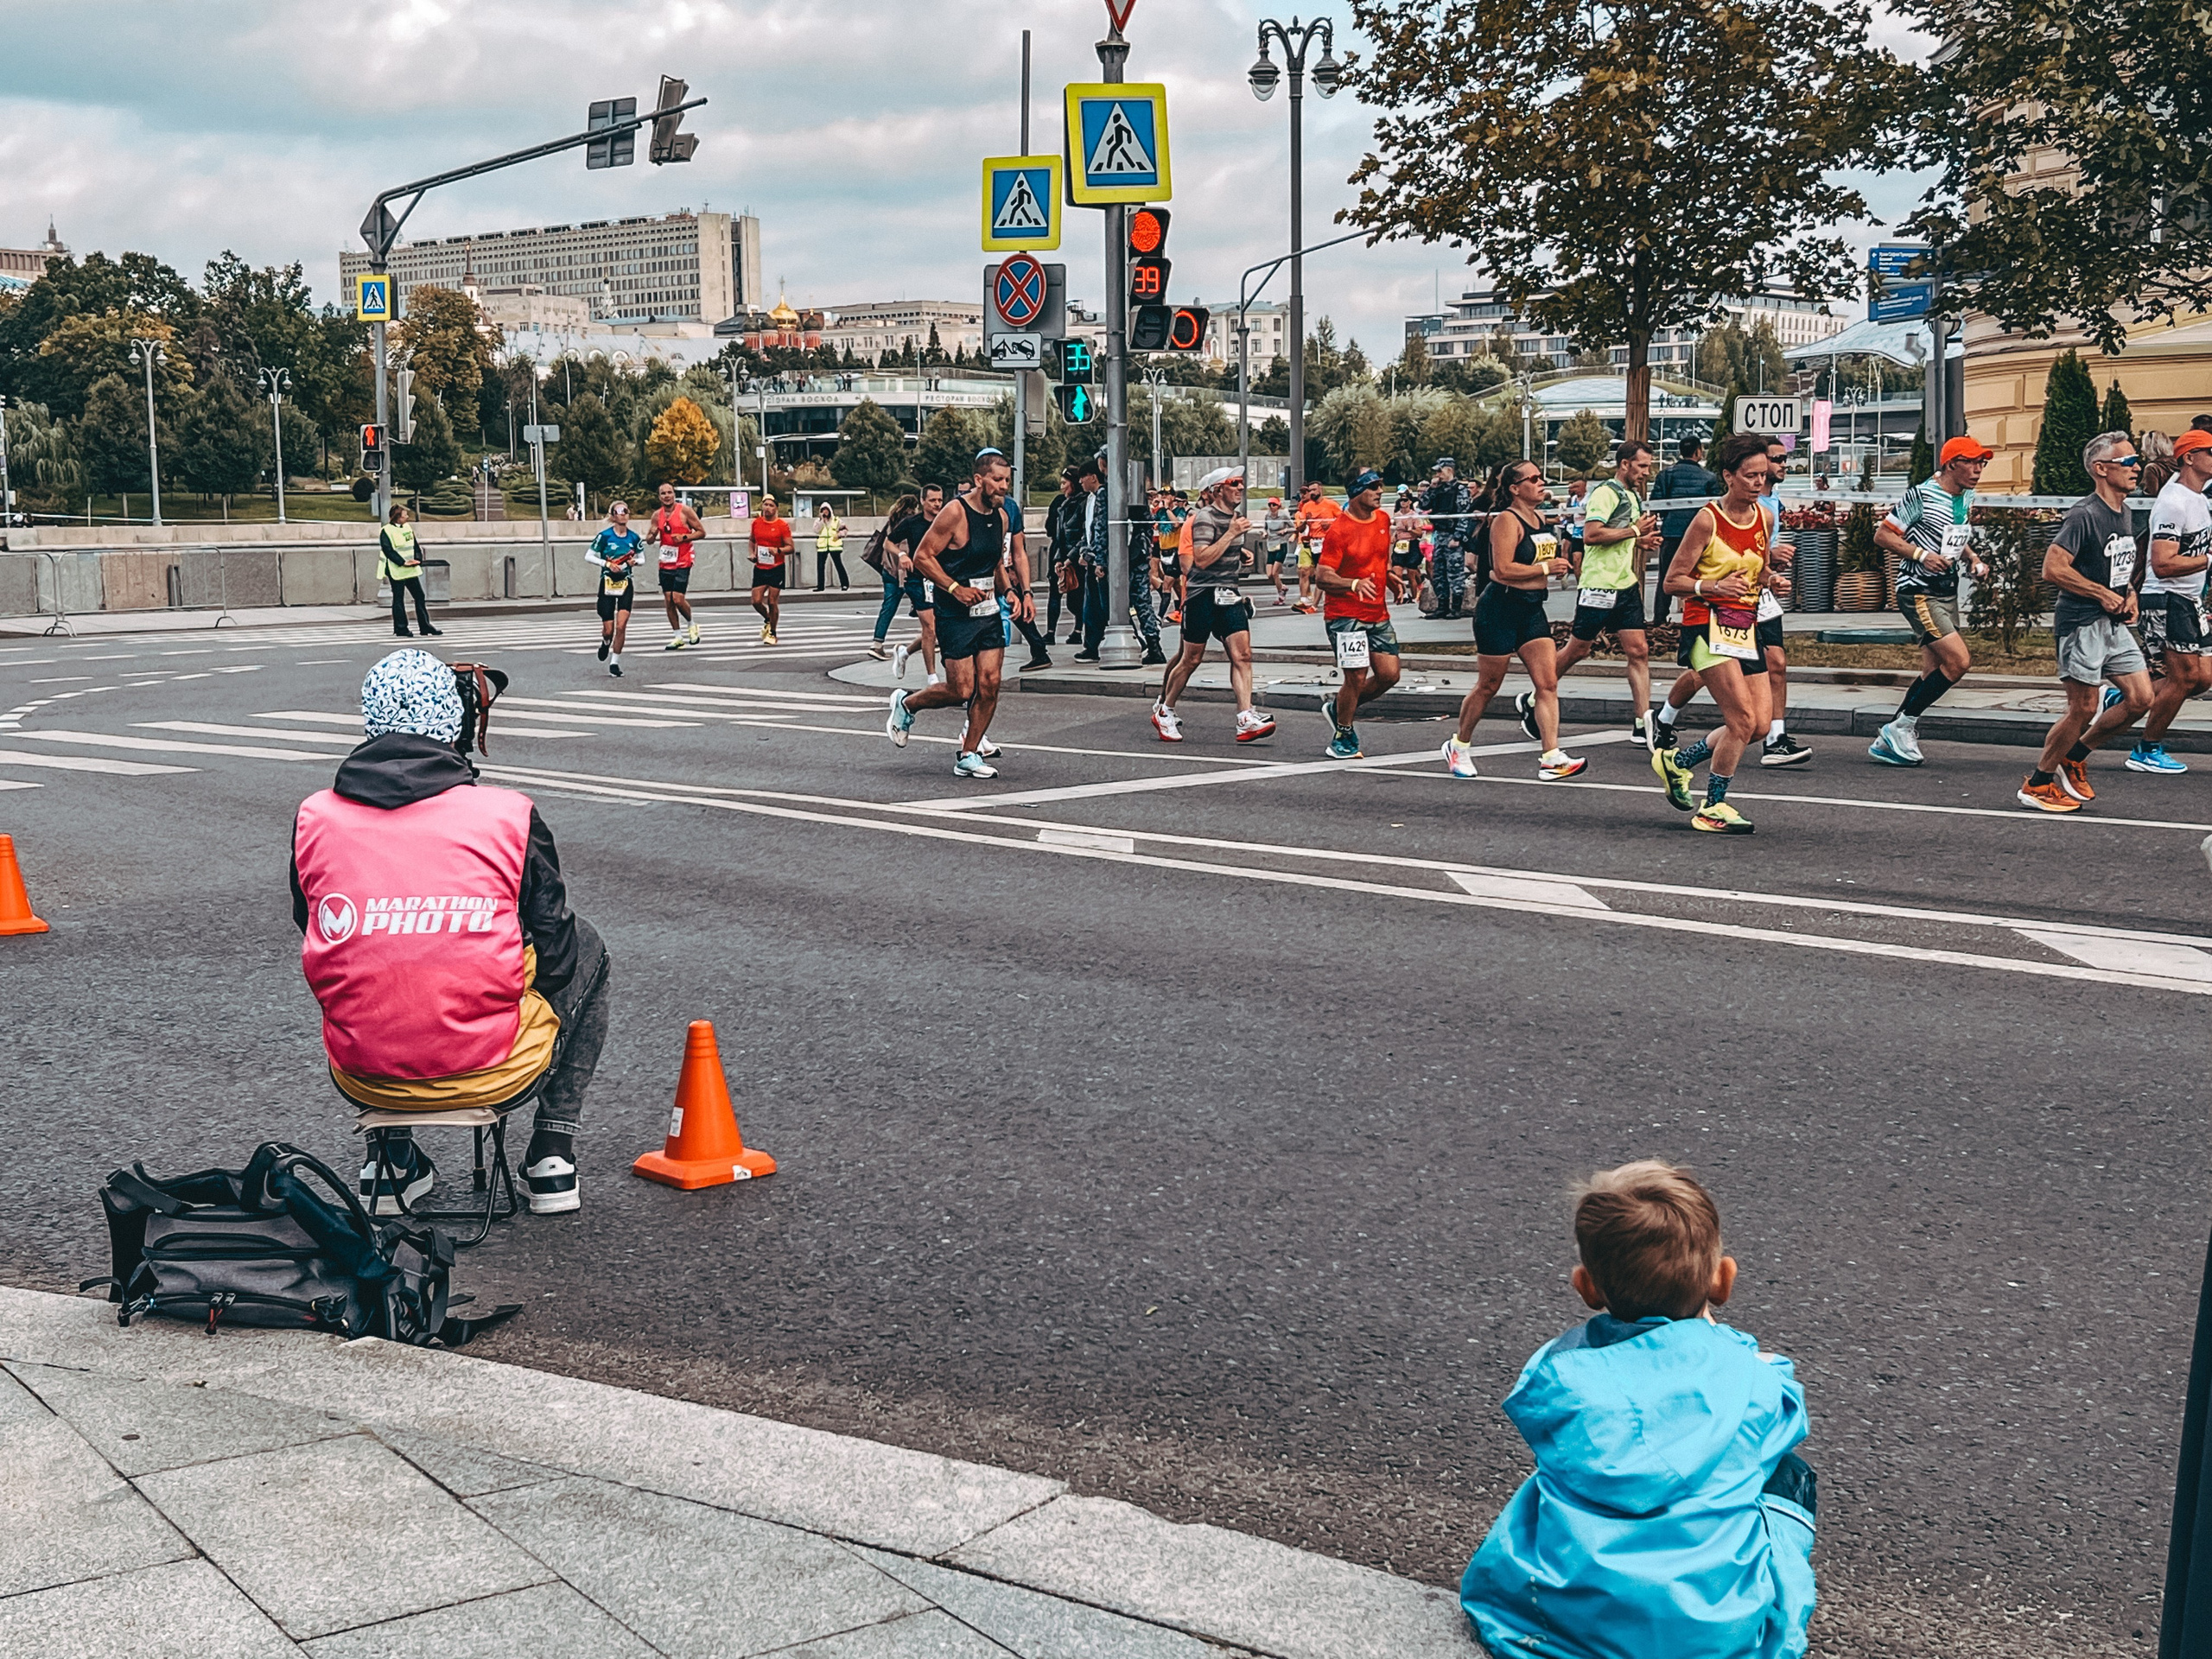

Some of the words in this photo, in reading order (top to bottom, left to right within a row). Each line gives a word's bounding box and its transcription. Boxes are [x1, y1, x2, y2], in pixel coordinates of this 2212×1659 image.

[1135, 266, 1160, 293] 39
[1066, 344, 1090, 371] 35
[1745, 403, 1794, 429] СТОП
[1341, 640, 1366, 653] 1429
[365, 896, 498, 912] MARATHON
[361, 911, 494, 935] PHOTO
